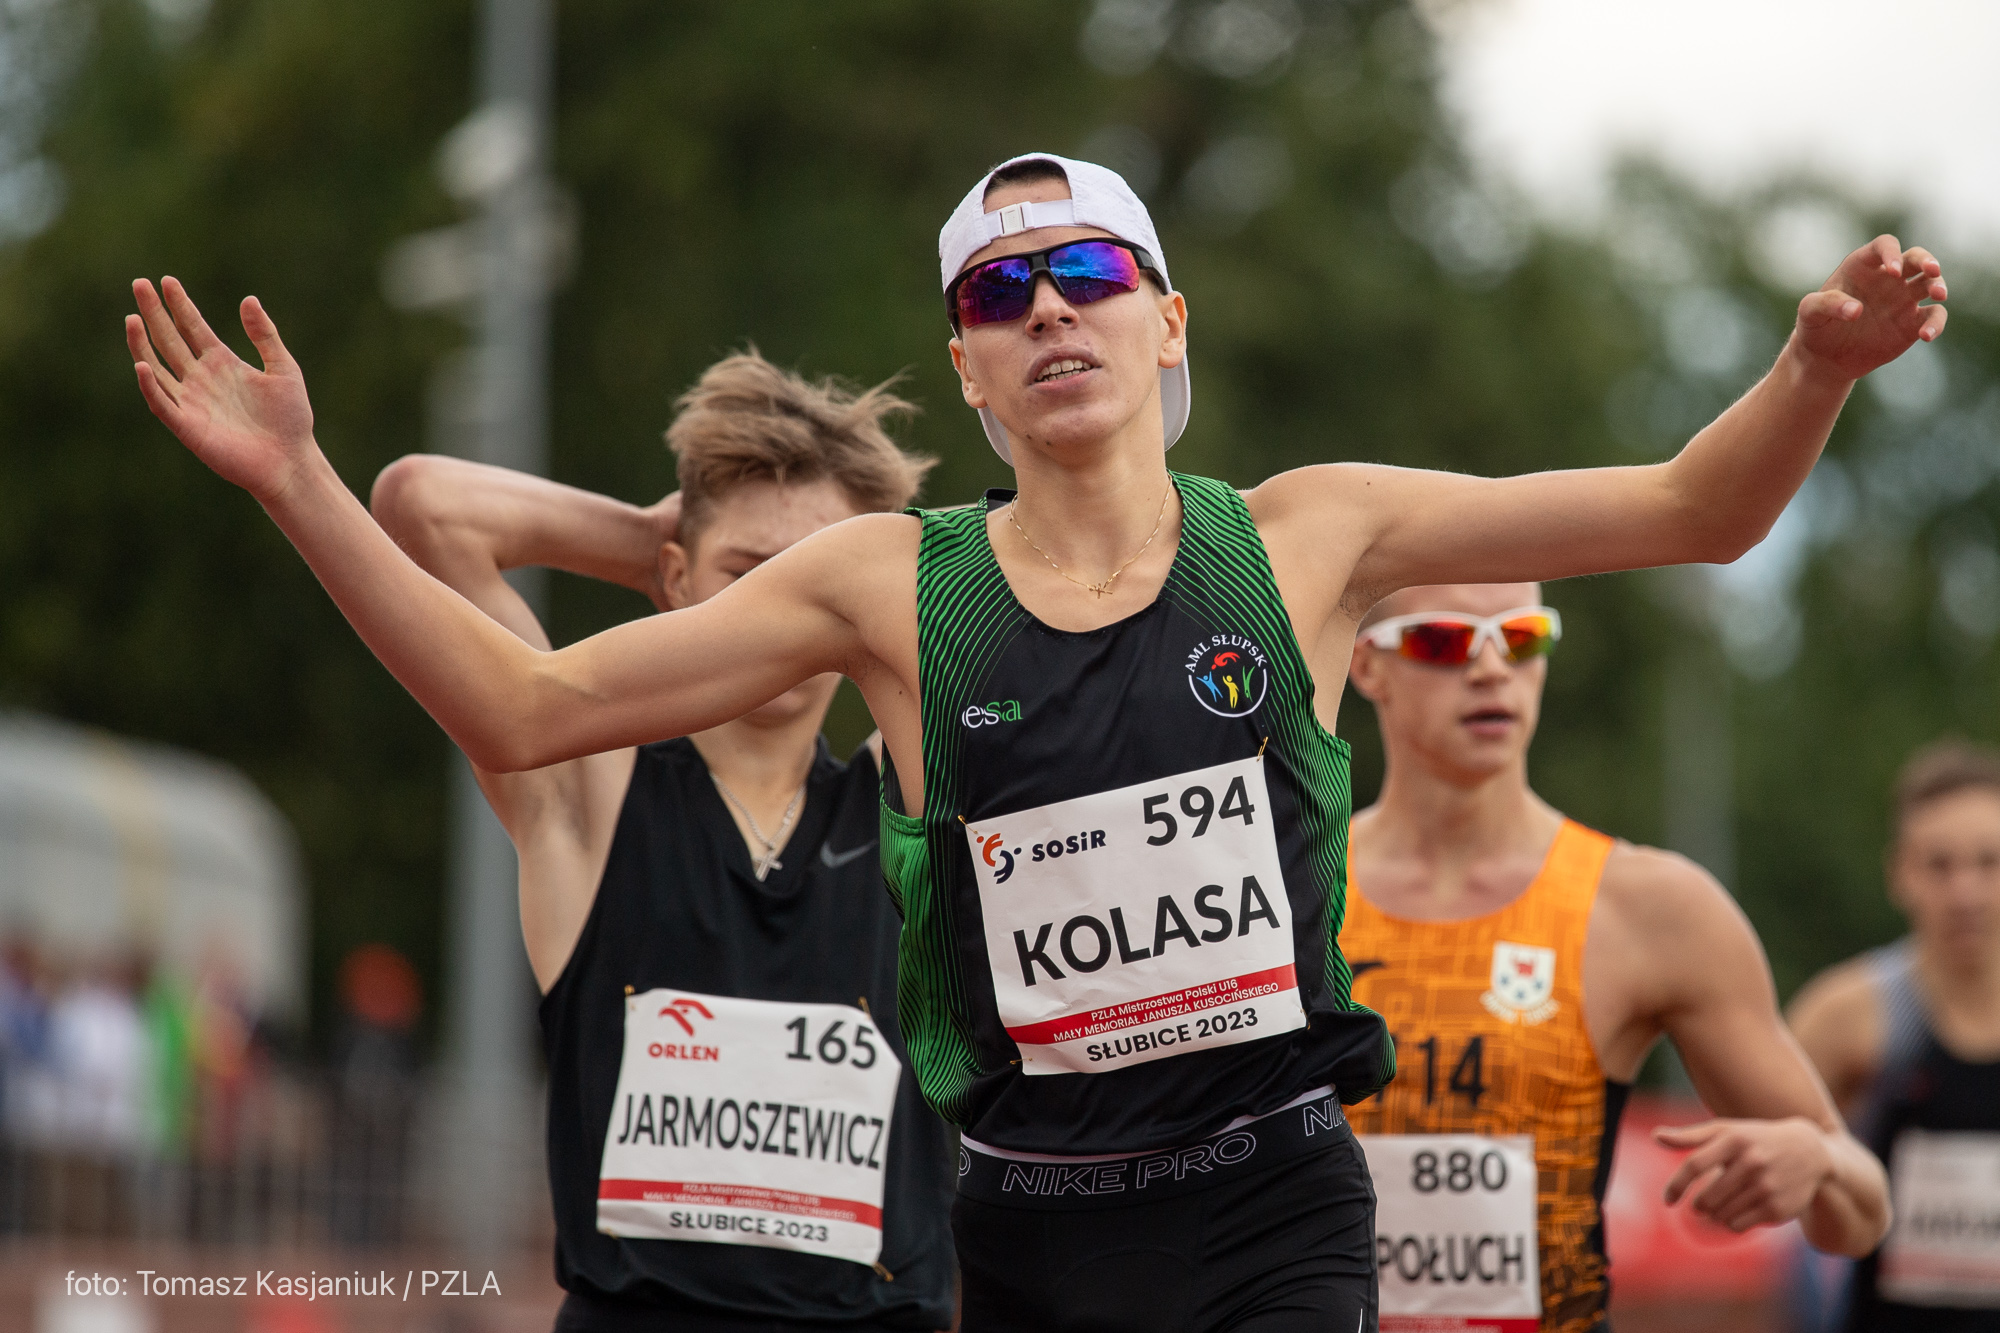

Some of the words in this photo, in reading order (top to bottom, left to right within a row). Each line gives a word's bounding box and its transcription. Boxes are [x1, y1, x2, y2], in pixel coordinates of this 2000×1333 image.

[1185, 642, 1211, 673] AML
[1211, 634, 1267, 668] SŁUPSK
[961, 700, 1024, 729] esa
[1142, 775, 1255, 847] 594
[1012, 875, 1281, 988] KOLASA
[1053, 1027, 1082, 1042] MAŁY
[1084, 1015, 1141, 1036] MEMORIAŁ
[1142, 1004, 1192, 1023] JANUSZA
[1193, 982, 1279, 1011] KUSOCIŃSKIEGO
[1091, 1008, 1117, 1022] PZLA
[1118, 993, 1184, 1016] Mistrzostwa
[1185, 983, 1218, 1000] Polski
[1218, 979, 1238, 992] U16
[648, 1042, 720, 1062] ORLEN
[785, 1016, 877, 1069] 165
[1086, 1024, 1192, 1062] SŁUBICE
[1195, 1007, 1259, 1039] 2023
[617, 1093, 886, 1170] JARMOSZEWICZ
[1002, 1163, 1128, 1196] NIKE
[1136, 1132, 1257, 1189] PRO
[1411, 1148, 1509, 1193] 880
[669, 1211, 767, 1235] SŁUBICE
[774, 1220, 829, 1242] 2023
